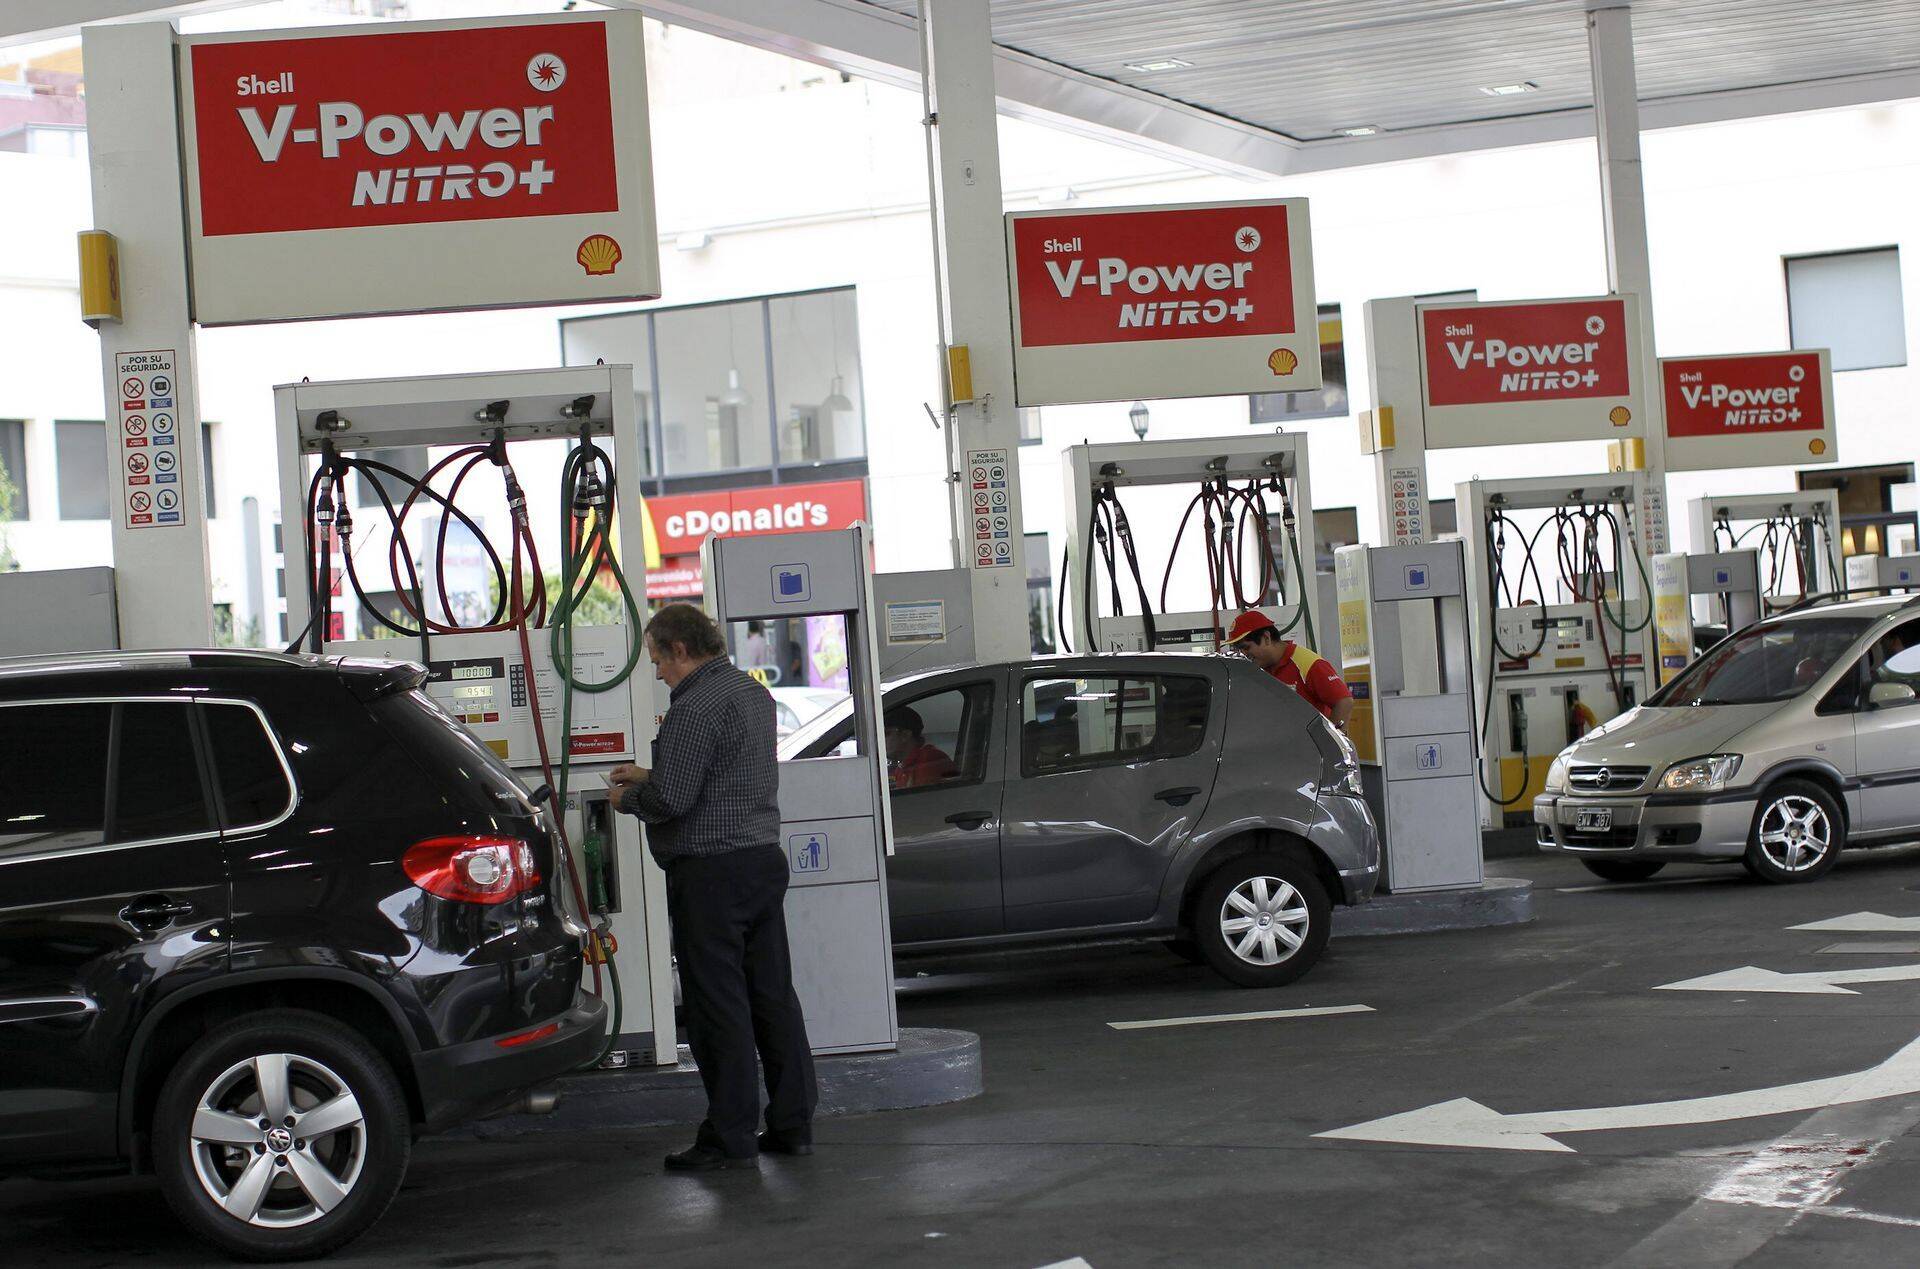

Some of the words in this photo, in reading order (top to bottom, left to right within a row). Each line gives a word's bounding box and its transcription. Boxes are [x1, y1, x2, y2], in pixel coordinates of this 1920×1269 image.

[236, 72, 294, 96] Shell
[236, 101, 554, 162] V-Power
[1043, 237, 1082, 253] Shell
[1044, 257, 1253, 298] V-Power
[1445, 324, 1473, 336] Shell
[129, 356, 148, 364] POR
[150, 355, 162, 363] SU
[1446, 339, 1599, 370] V-Power
[121, 362, 171, 373] SEGURIDAD
[1679, 372, 1702, 383] Shell
[1680, 384, 1800, 409] V-Power
[971, 457, 1005, 465] SEGURIDAD
